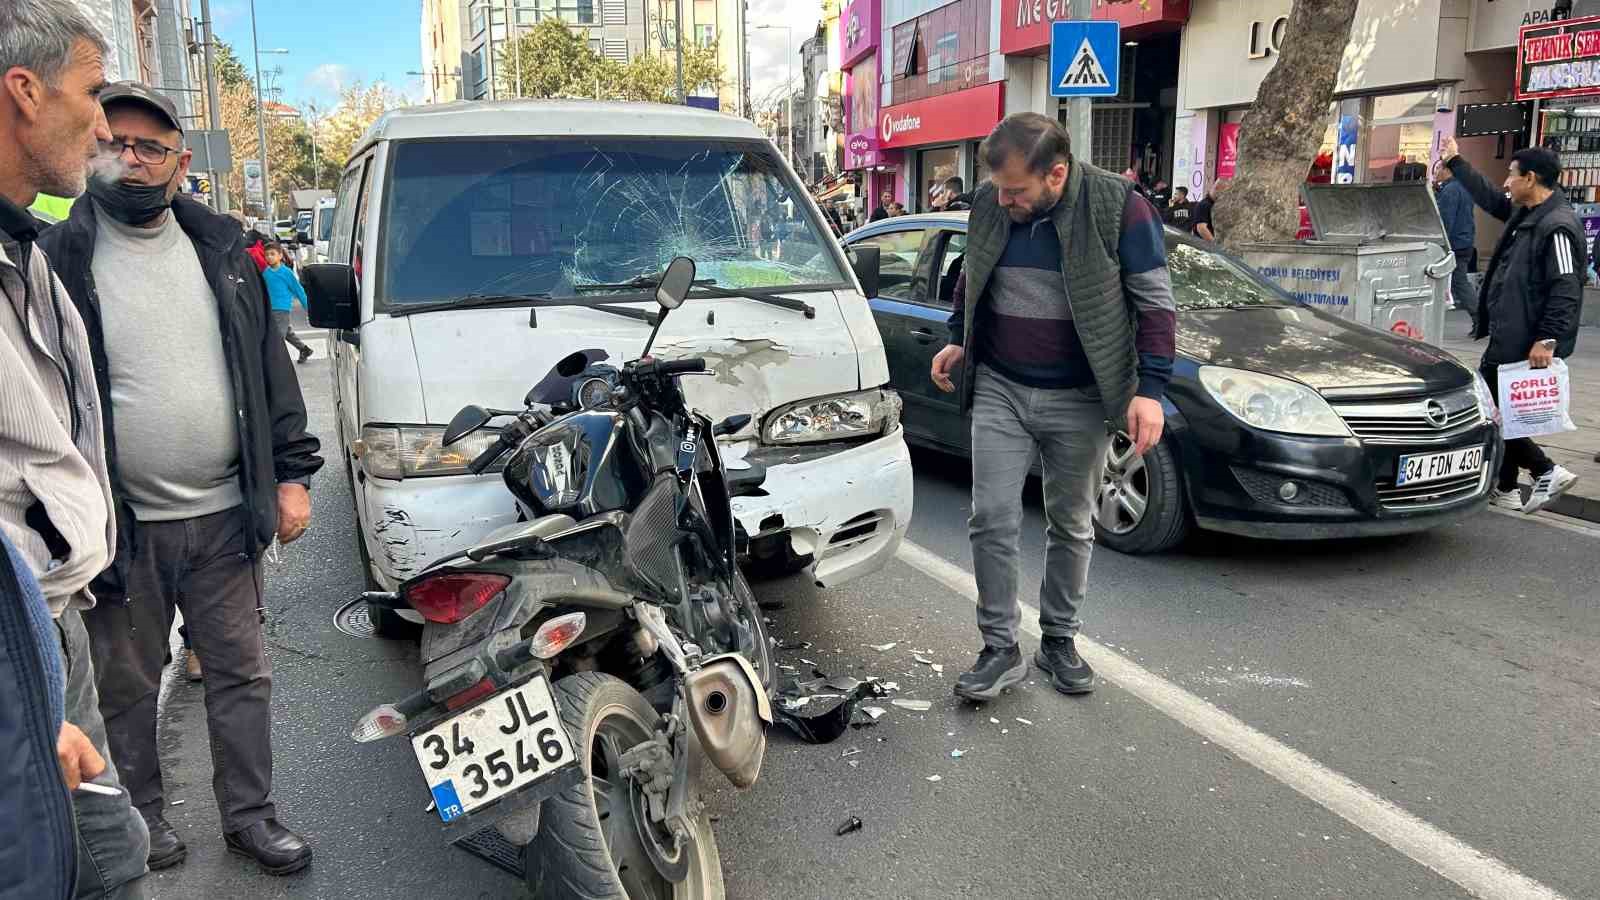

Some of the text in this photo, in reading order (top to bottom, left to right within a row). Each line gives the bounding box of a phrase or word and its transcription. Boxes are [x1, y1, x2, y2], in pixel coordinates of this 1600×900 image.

[893, 114, 920, 132] vodafone
[851, 140, 868, 150] eve
[1511, 388, 1559, 401] NURS
[1407, 458, 1423, 480] 34
[1429, 454, 1454, 478] FDN
[1459, 449, 1481, 471] 430
[423, 691, 549, 770] 34 JL
[462, 728, 564, 799] 3546
[443, 804, 461, 818] TR
